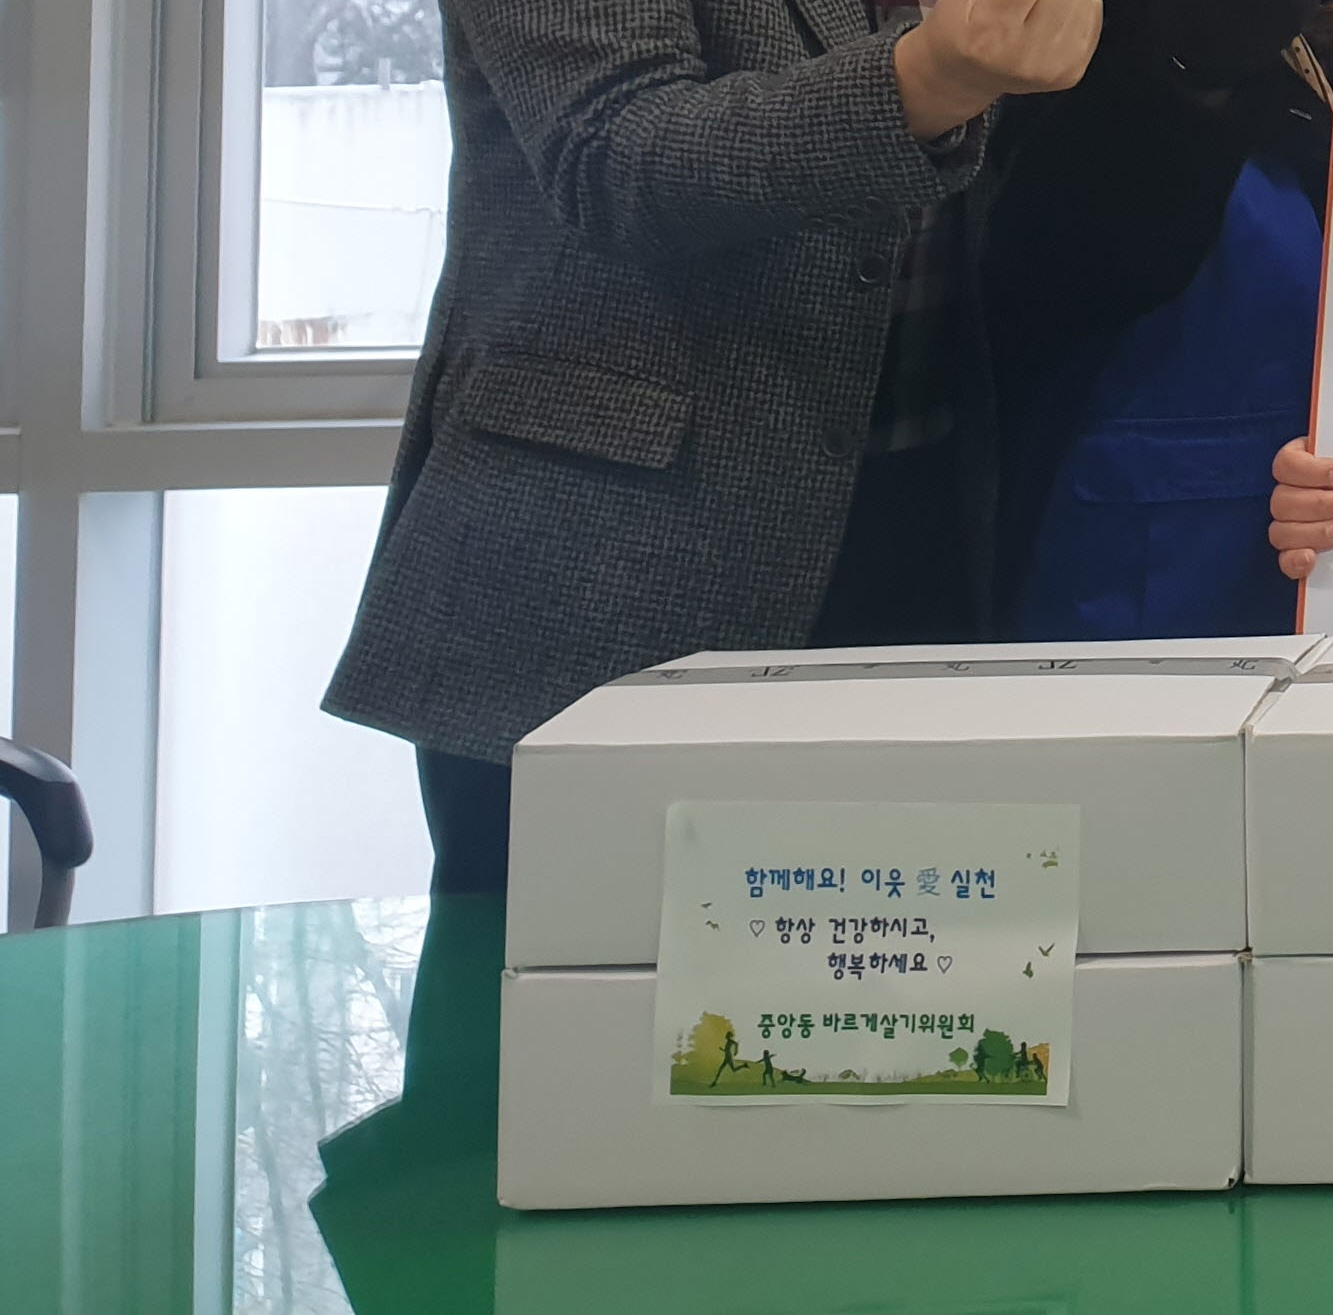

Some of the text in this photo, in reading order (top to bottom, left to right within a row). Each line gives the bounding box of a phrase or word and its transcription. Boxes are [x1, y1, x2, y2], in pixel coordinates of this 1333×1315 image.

[745, 867, 995, 898] 함께해요! 이웃 愛 실천
[775, 917, 934, 944] 항상 건강하시고,
[828, 952, 928, 980] 행복하세요
[758, 1013, 974, 1039] 중앙동 바르게살기위원회
